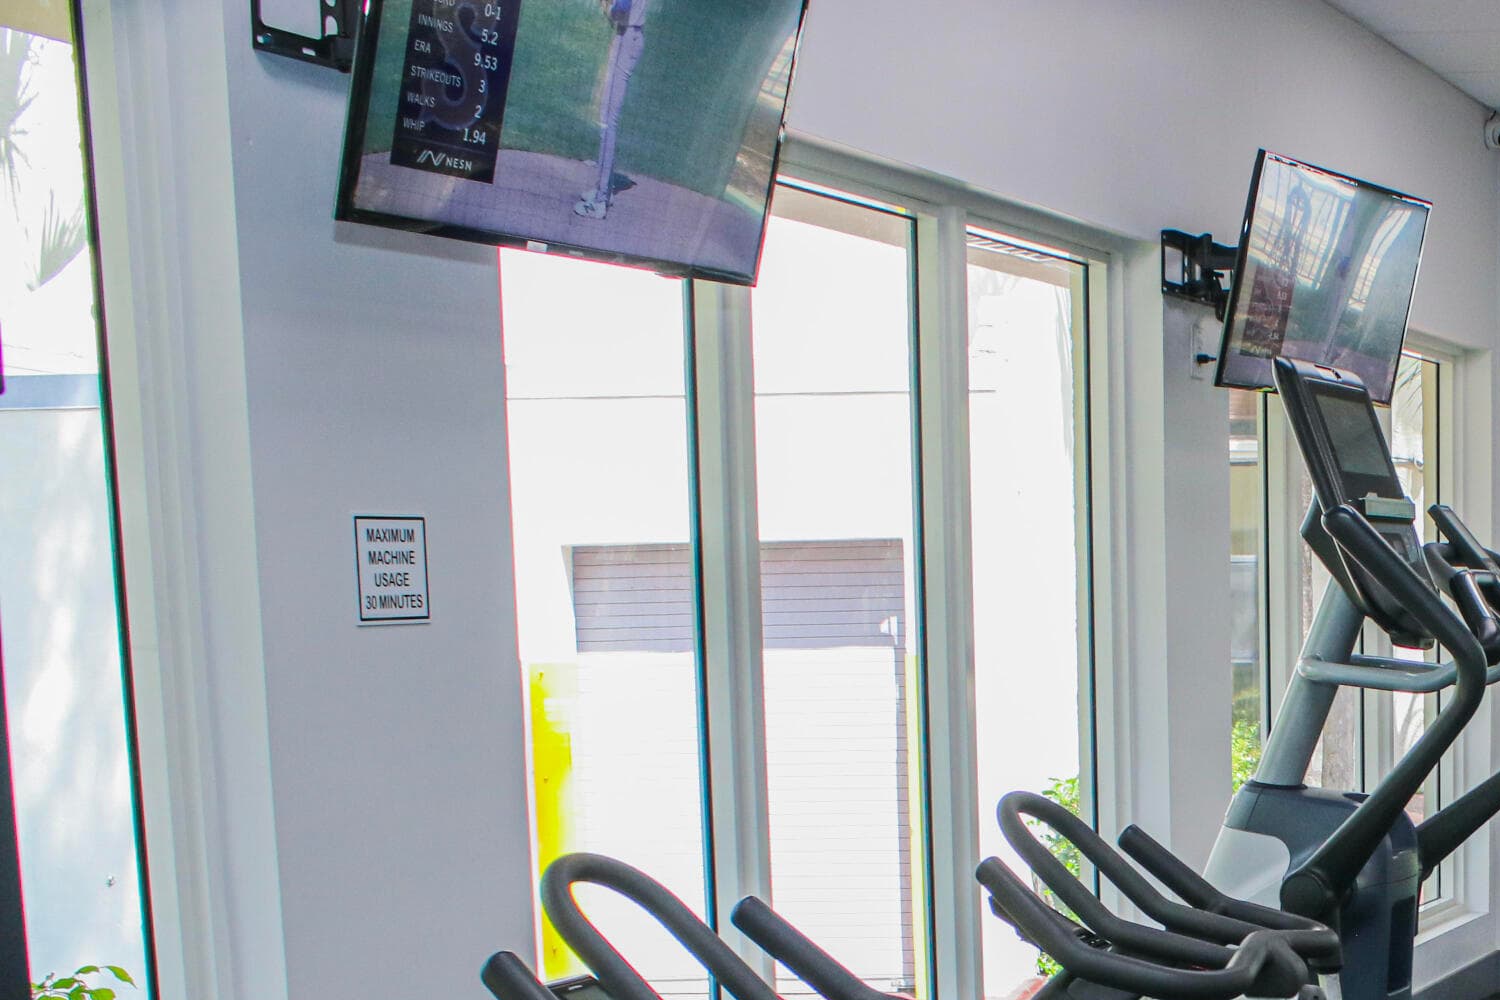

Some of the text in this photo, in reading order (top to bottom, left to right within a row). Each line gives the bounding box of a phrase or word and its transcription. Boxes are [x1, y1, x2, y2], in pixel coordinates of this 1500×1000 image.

[484, 4, 502, 20] 0-1
[418, 14, 499, 45] INNINGS 5.2
[414, 40, 498, 71] ERA 9.53
[411, 65, 486, 93] STRIKEOUTS 3
[407, 91, 482, 119] WALKS 2
[403, 117, 486, 145] WHIP 1.94
[445, 157, 473, 171] NESN
[366, 528, 415, 543] MAXIMUM
[368, 550, 415, 565] MACHINE
[374, 572, 411, 587] USAGE
[366, 594, 424, 610] 30 MINUTES
